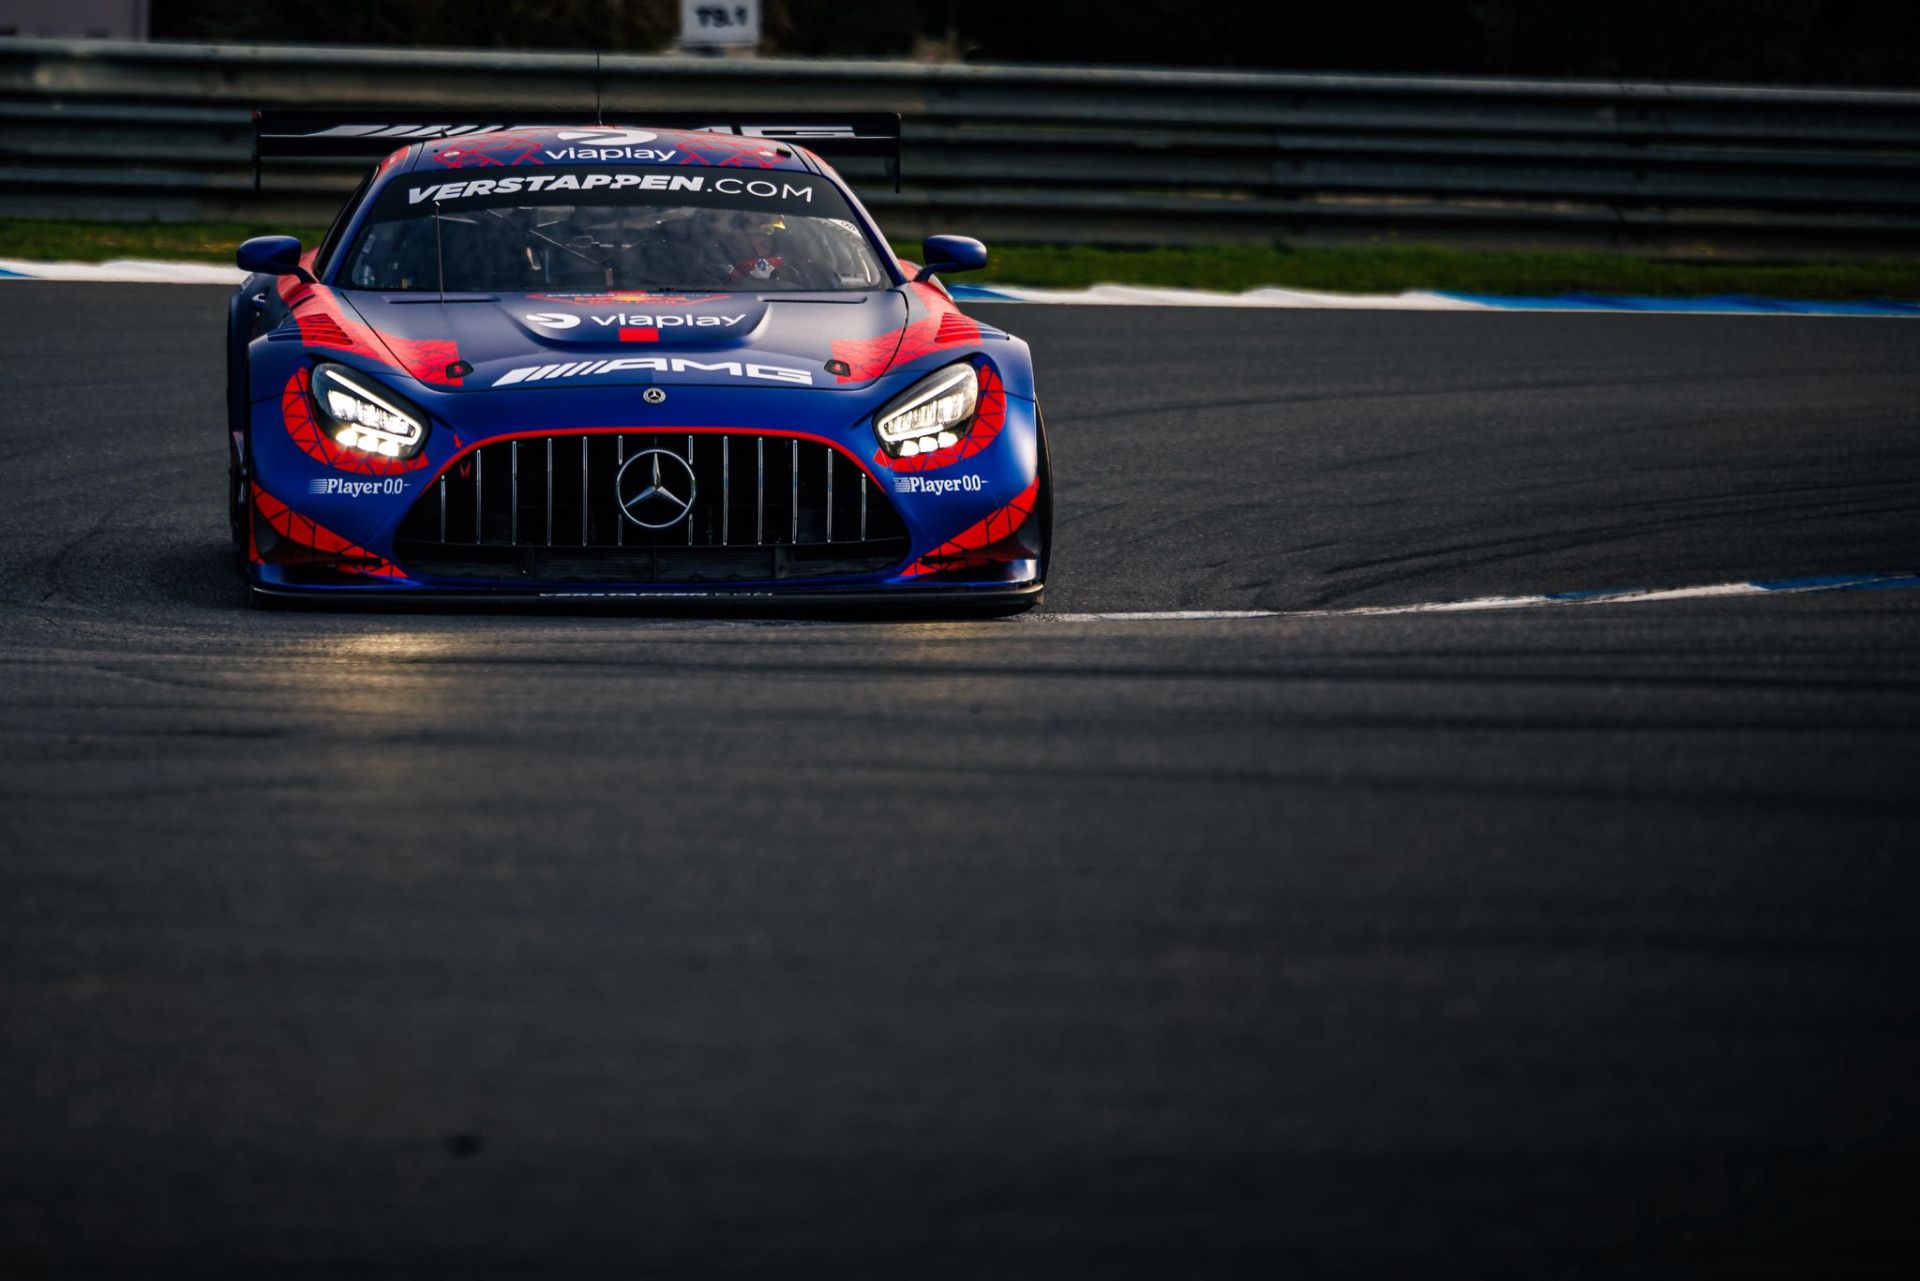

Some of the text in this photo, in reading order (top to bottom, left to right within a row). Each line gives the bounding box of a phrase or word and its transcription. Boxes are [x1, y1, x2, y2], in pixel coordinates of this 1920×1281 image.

[544, 148, 676, 162] viaplay
[408, 172, 812, 204] VERSTAPPEN.COM
[590, 313, 746, 329] viaplay
[596, 357, 812, 385] AMG
[326, 478, 382, 498] Player
[909, 476, 961, 496] Player
